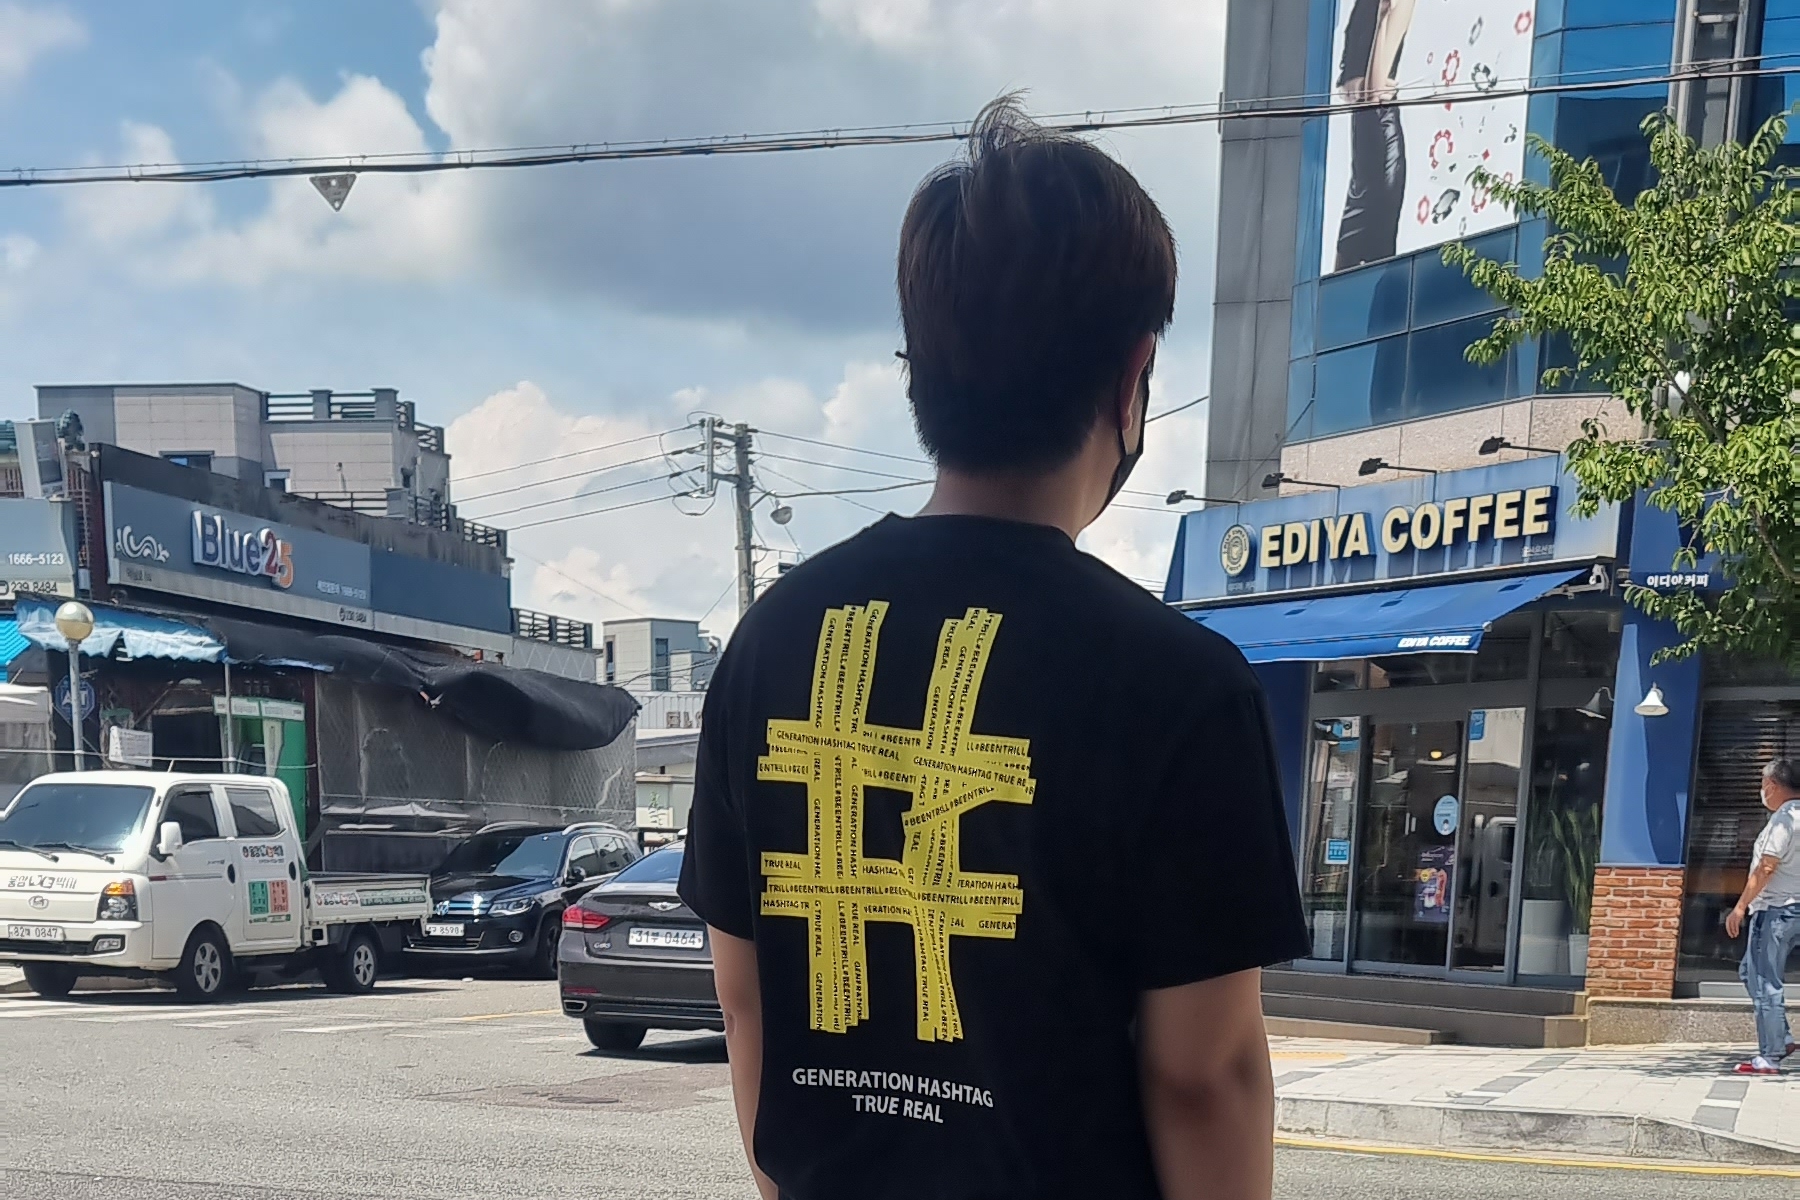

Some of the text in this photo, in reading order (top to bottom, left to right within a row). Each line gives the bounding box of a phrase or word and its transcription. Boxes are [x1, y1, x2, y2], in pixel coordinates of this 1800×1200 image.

[1260, 512, 1370, 568] EDIYA
[1381, 485, 1550, 554] COFFEE
[8, 553, 65, 565] 1666-5123
[192, 510, 294, 589] Blue25
[1398, 635, 1473, 649] EDIYA COFFEE
[61, 690, 88, 706] AT
[777, 730, 820, 746] GENERATION
[820, 737, 856, 751] HASHTAG
[858, 742, 877, 755] TRUE
[878, 748, 900, 761] REAL
[914, 756, 957, 774] GENERATION
[958, 765, 992, 780] HASHTAG
[994, 772, 1015, 785] TRUE
[664, 931, 697, 946] 0464
[792, 1067, 994, 1108] GENERATION HASHTAG
[852, 1094, 944, 1124] TRUE REAL
